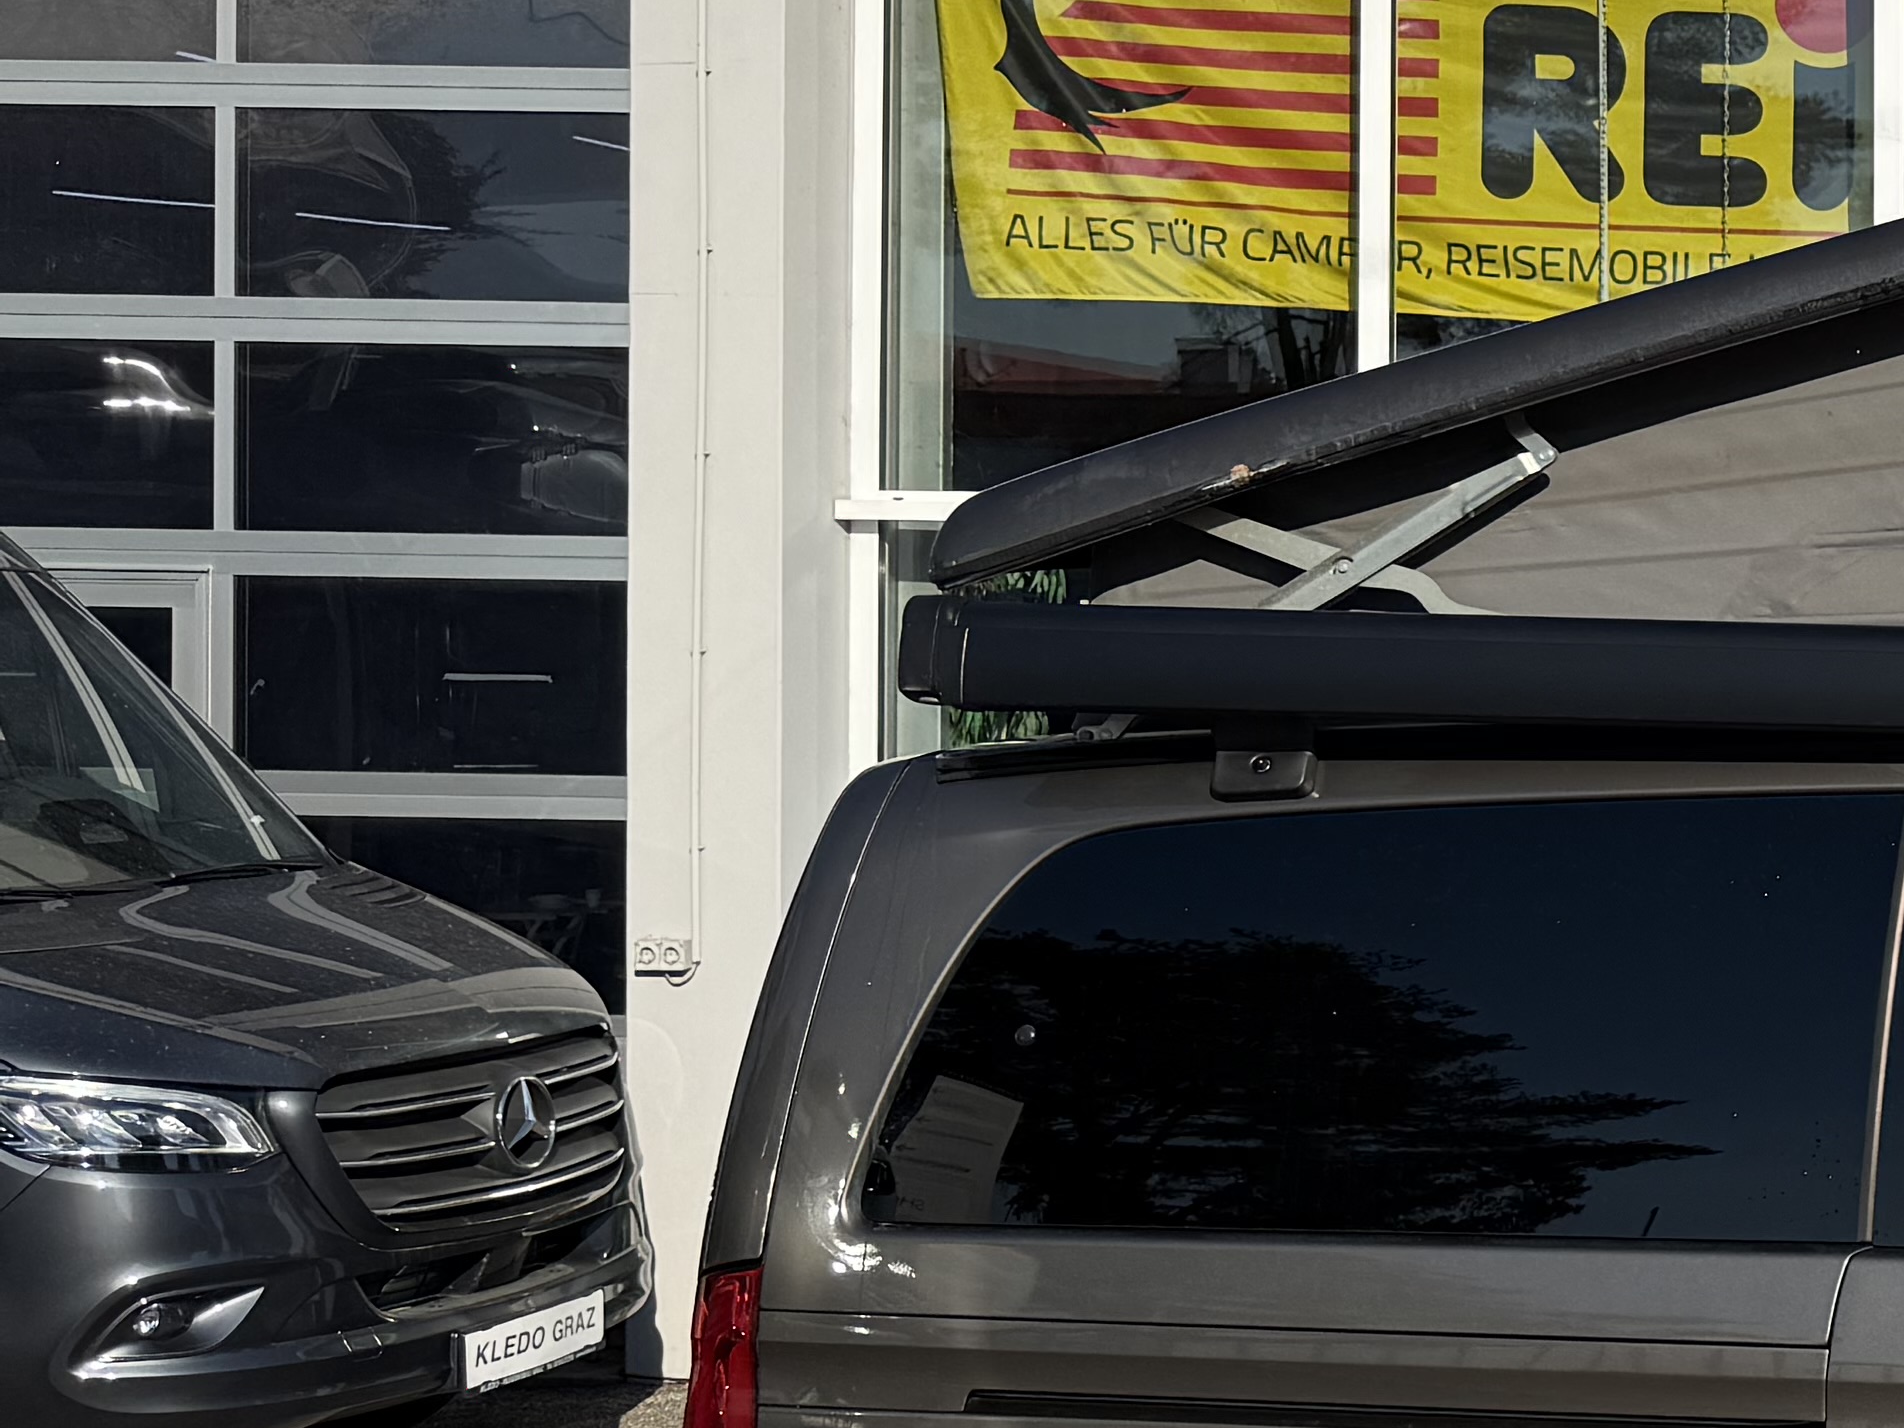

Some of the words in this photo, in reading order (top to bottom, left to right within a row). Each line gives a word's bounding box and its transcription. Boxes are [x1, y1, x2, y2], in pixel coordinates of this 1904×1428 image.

[1005, 214, 1135, 253] ALLES
[1146, 218, 1228, 260] FÜR
[475, 1326, 545, 1368] KLEDO
[552, 1306, 596, 1342] GRAZ
